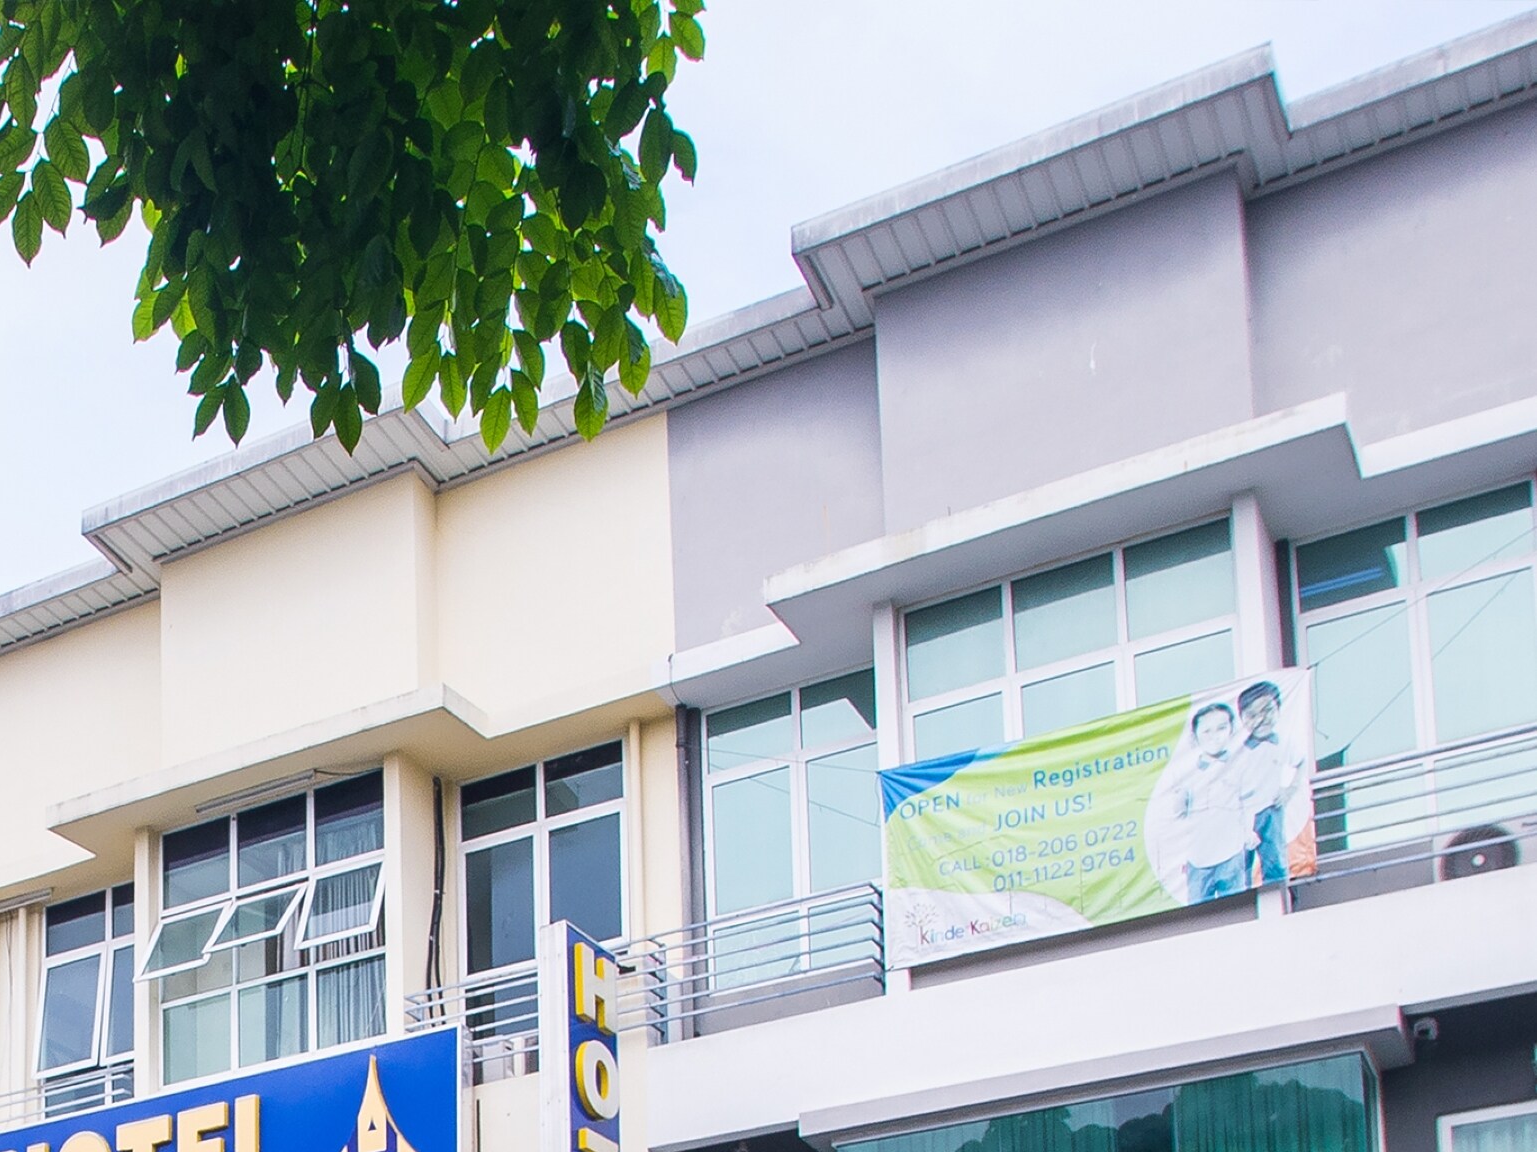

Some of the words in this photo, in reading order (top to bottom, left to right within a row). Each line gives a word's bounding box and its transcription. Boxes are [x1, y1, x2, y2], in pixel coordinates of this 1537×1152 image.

[899, 791, 961, 821] OPEN
[994, 782, 1028, 799] New
[1032, 745, 1170, 789] Registration
[993, 804, 1046, 832] JOIN
[1055, 792, 1093, 817] US!
[939, 856, 981, 876] CALL
[1085, 820, 1138, 847] 0722
[993, 859, 1076, 892] 011-1122
[1081, 846, 1136, 873] 9764
